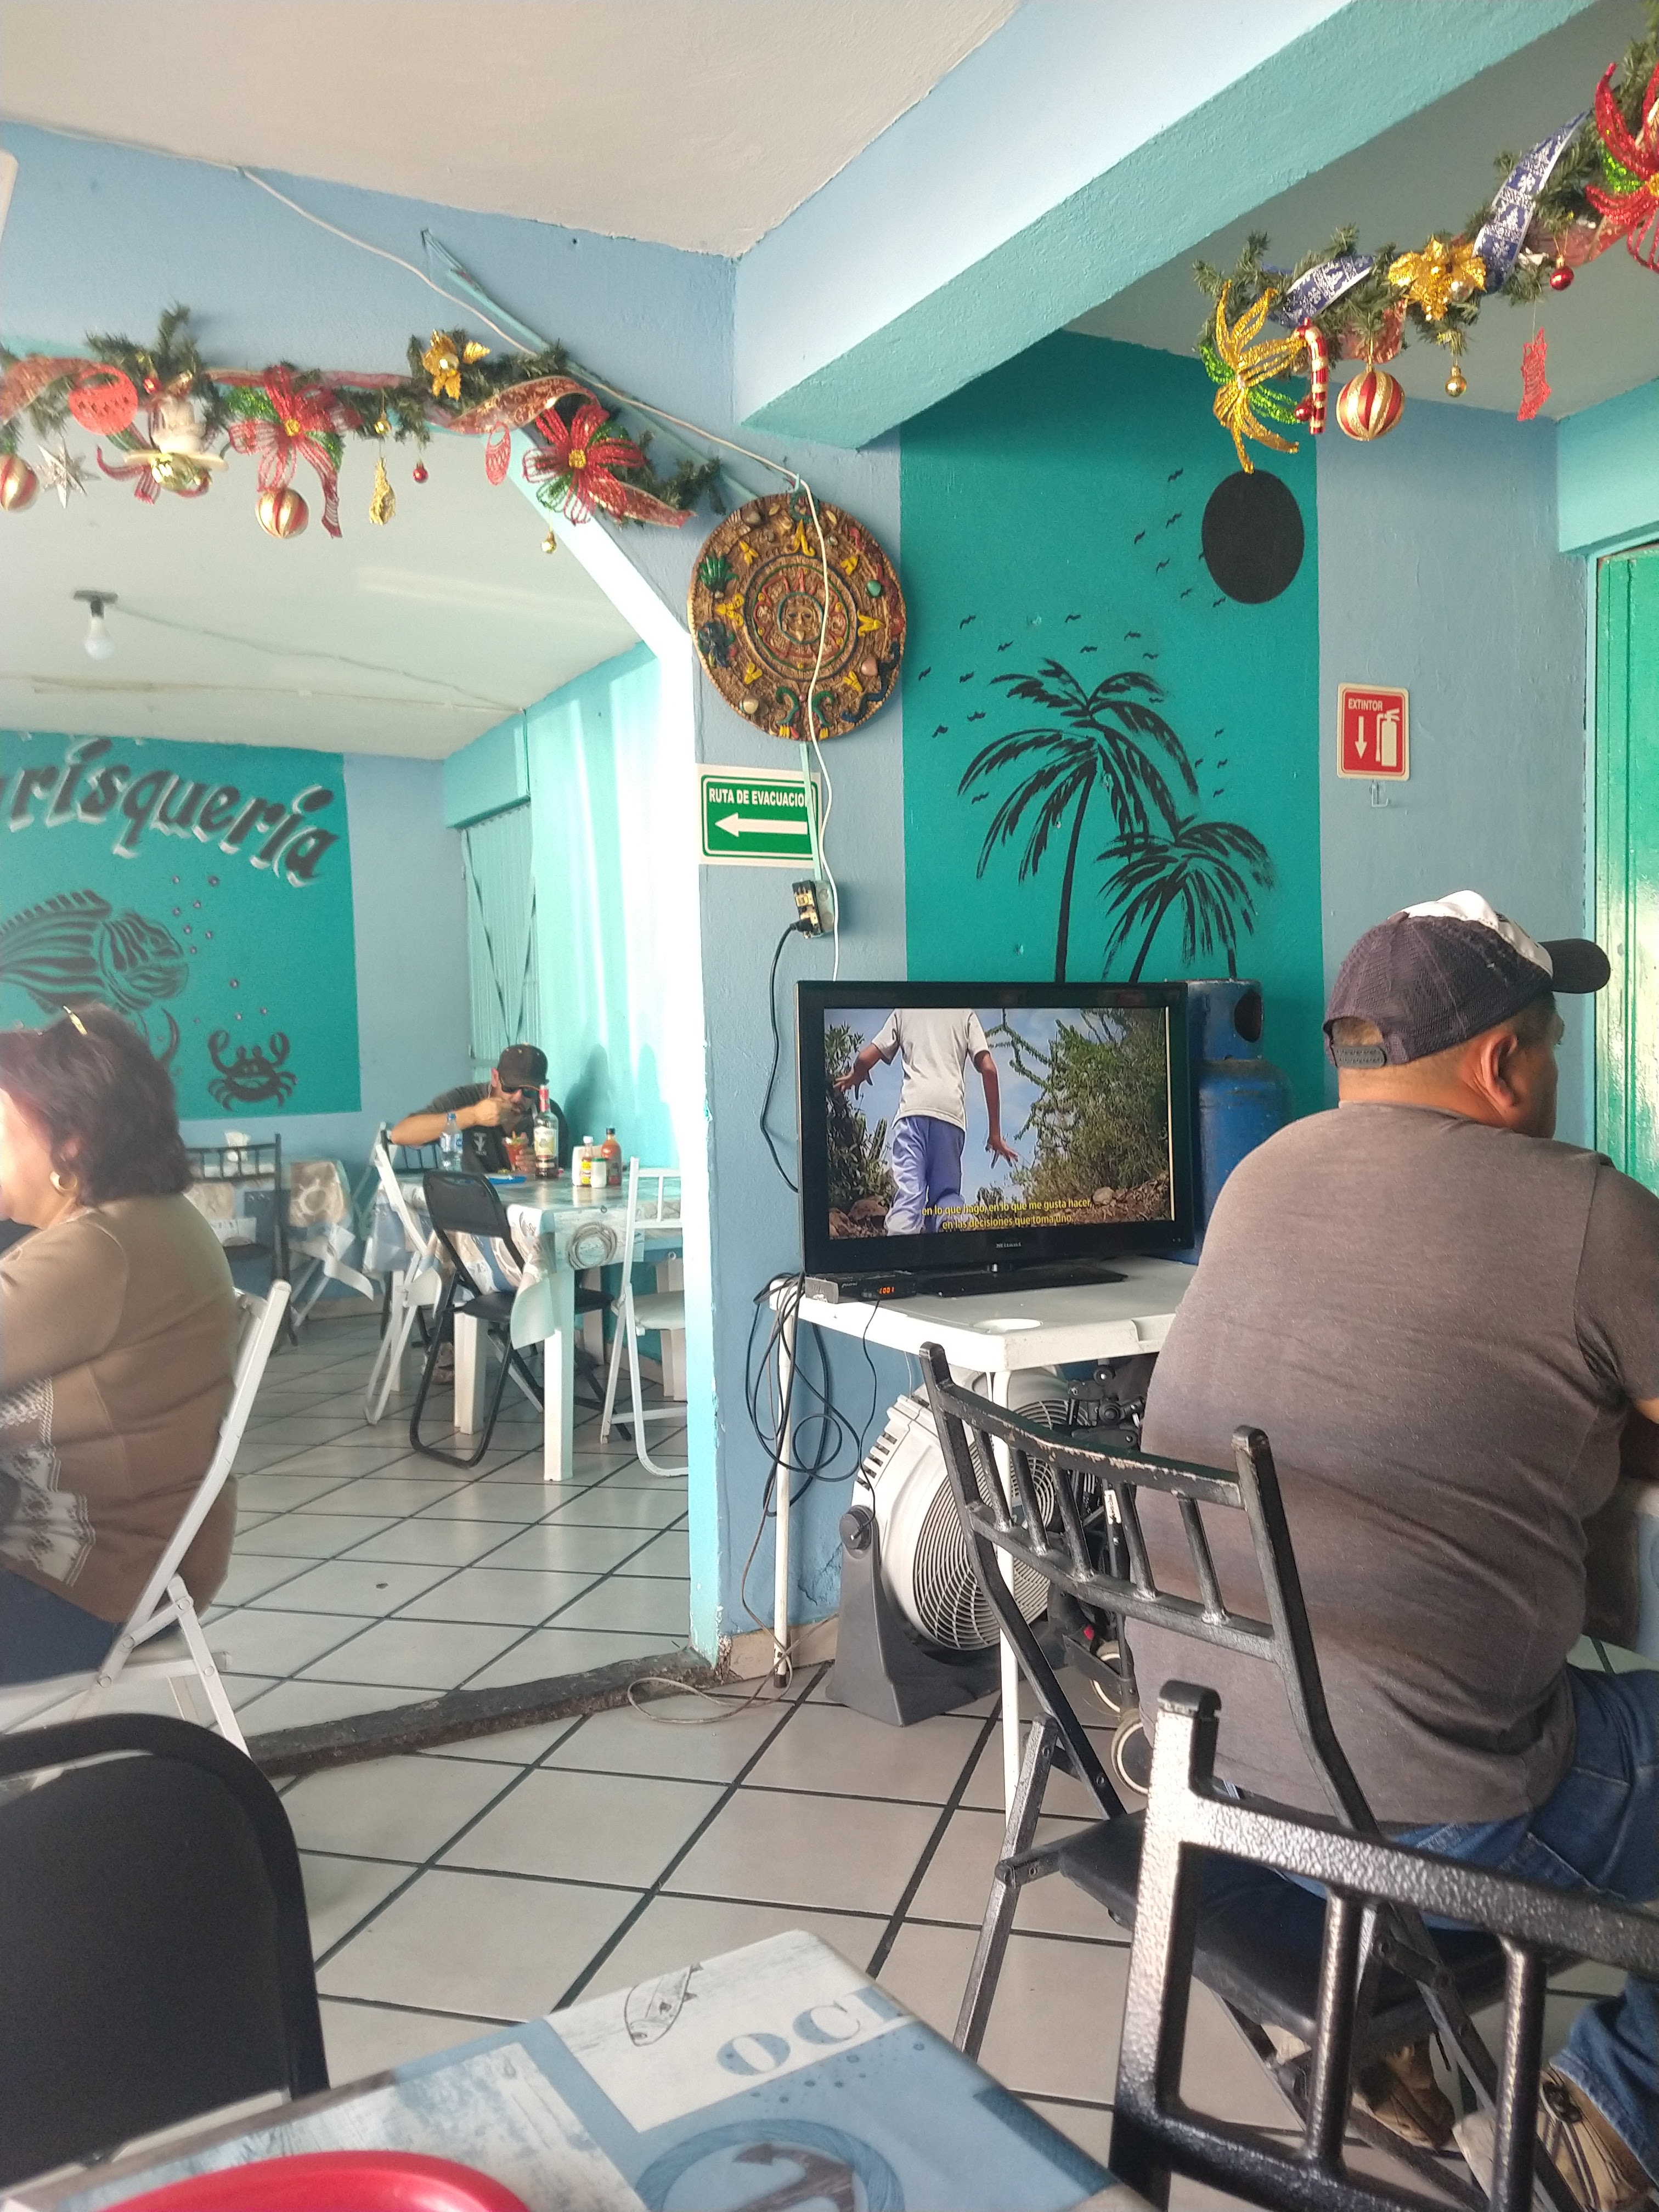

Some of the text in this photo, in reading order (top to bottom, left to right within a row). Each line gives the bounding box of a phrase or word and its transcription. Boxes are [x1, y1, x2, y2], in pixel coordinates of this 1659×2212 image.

[1348, 698, 1383, 712] EXTINTOR
[709, 788, 735, 804] RUTA
[736, 789, 749, 804] DE
[922, 1207, 933, 1216] en
[934, 1204, 943, 1215] lo
[945, 1206, 961, 1216] que
[1001, 1202, 1009, 1212] lo
[1011, 1201, 1027, 1213] que
[1029, 1201, 1042, 1210] me
[1043, 1199, 1066, 1212] gusta
[942, 1221, 953, 1230] en
[955, 1218, 967, 1228] las
[968, 1217, 1013, 1228] decisiones
[1015, 1216, 1031, 1228] que
[1032, 1215, 1054, 1224] toma
